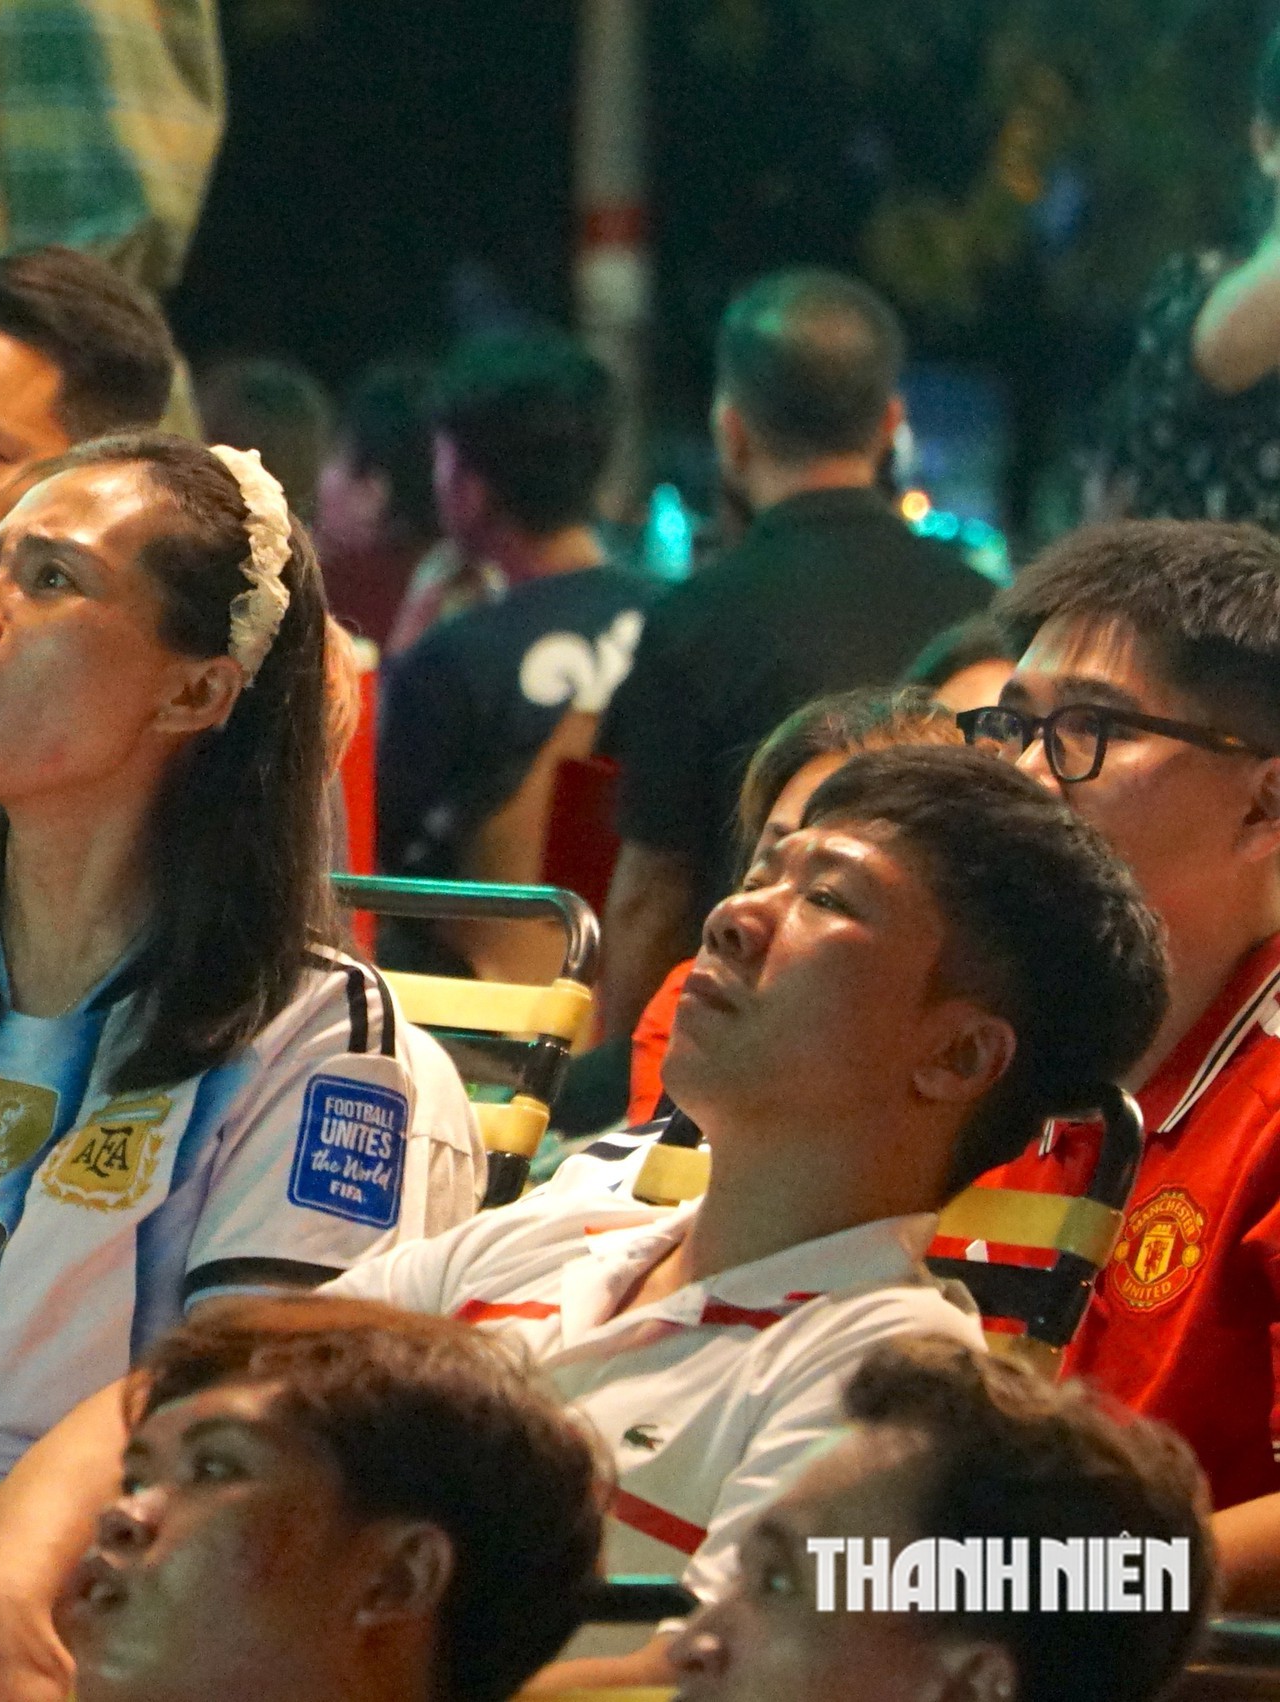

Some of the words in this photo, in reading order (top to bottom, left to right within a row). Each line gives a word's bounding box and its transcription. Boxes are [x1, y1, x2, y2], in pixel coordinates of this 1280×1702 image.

[324, 1097, 394, 1131] FOOTBALL
[72, 1126, 133, 1178] AFA
[320, 1117, 392, 1160] UNITES
[311, 1149, 340, 1173] the
[342, 1155, 392, 1191] World
[329, 1180, 363, 1203] FIFA
[1131, 1200, 1197, 1237] MANCHESTER
[1122, 1279, 1171, 1299] UNITED
